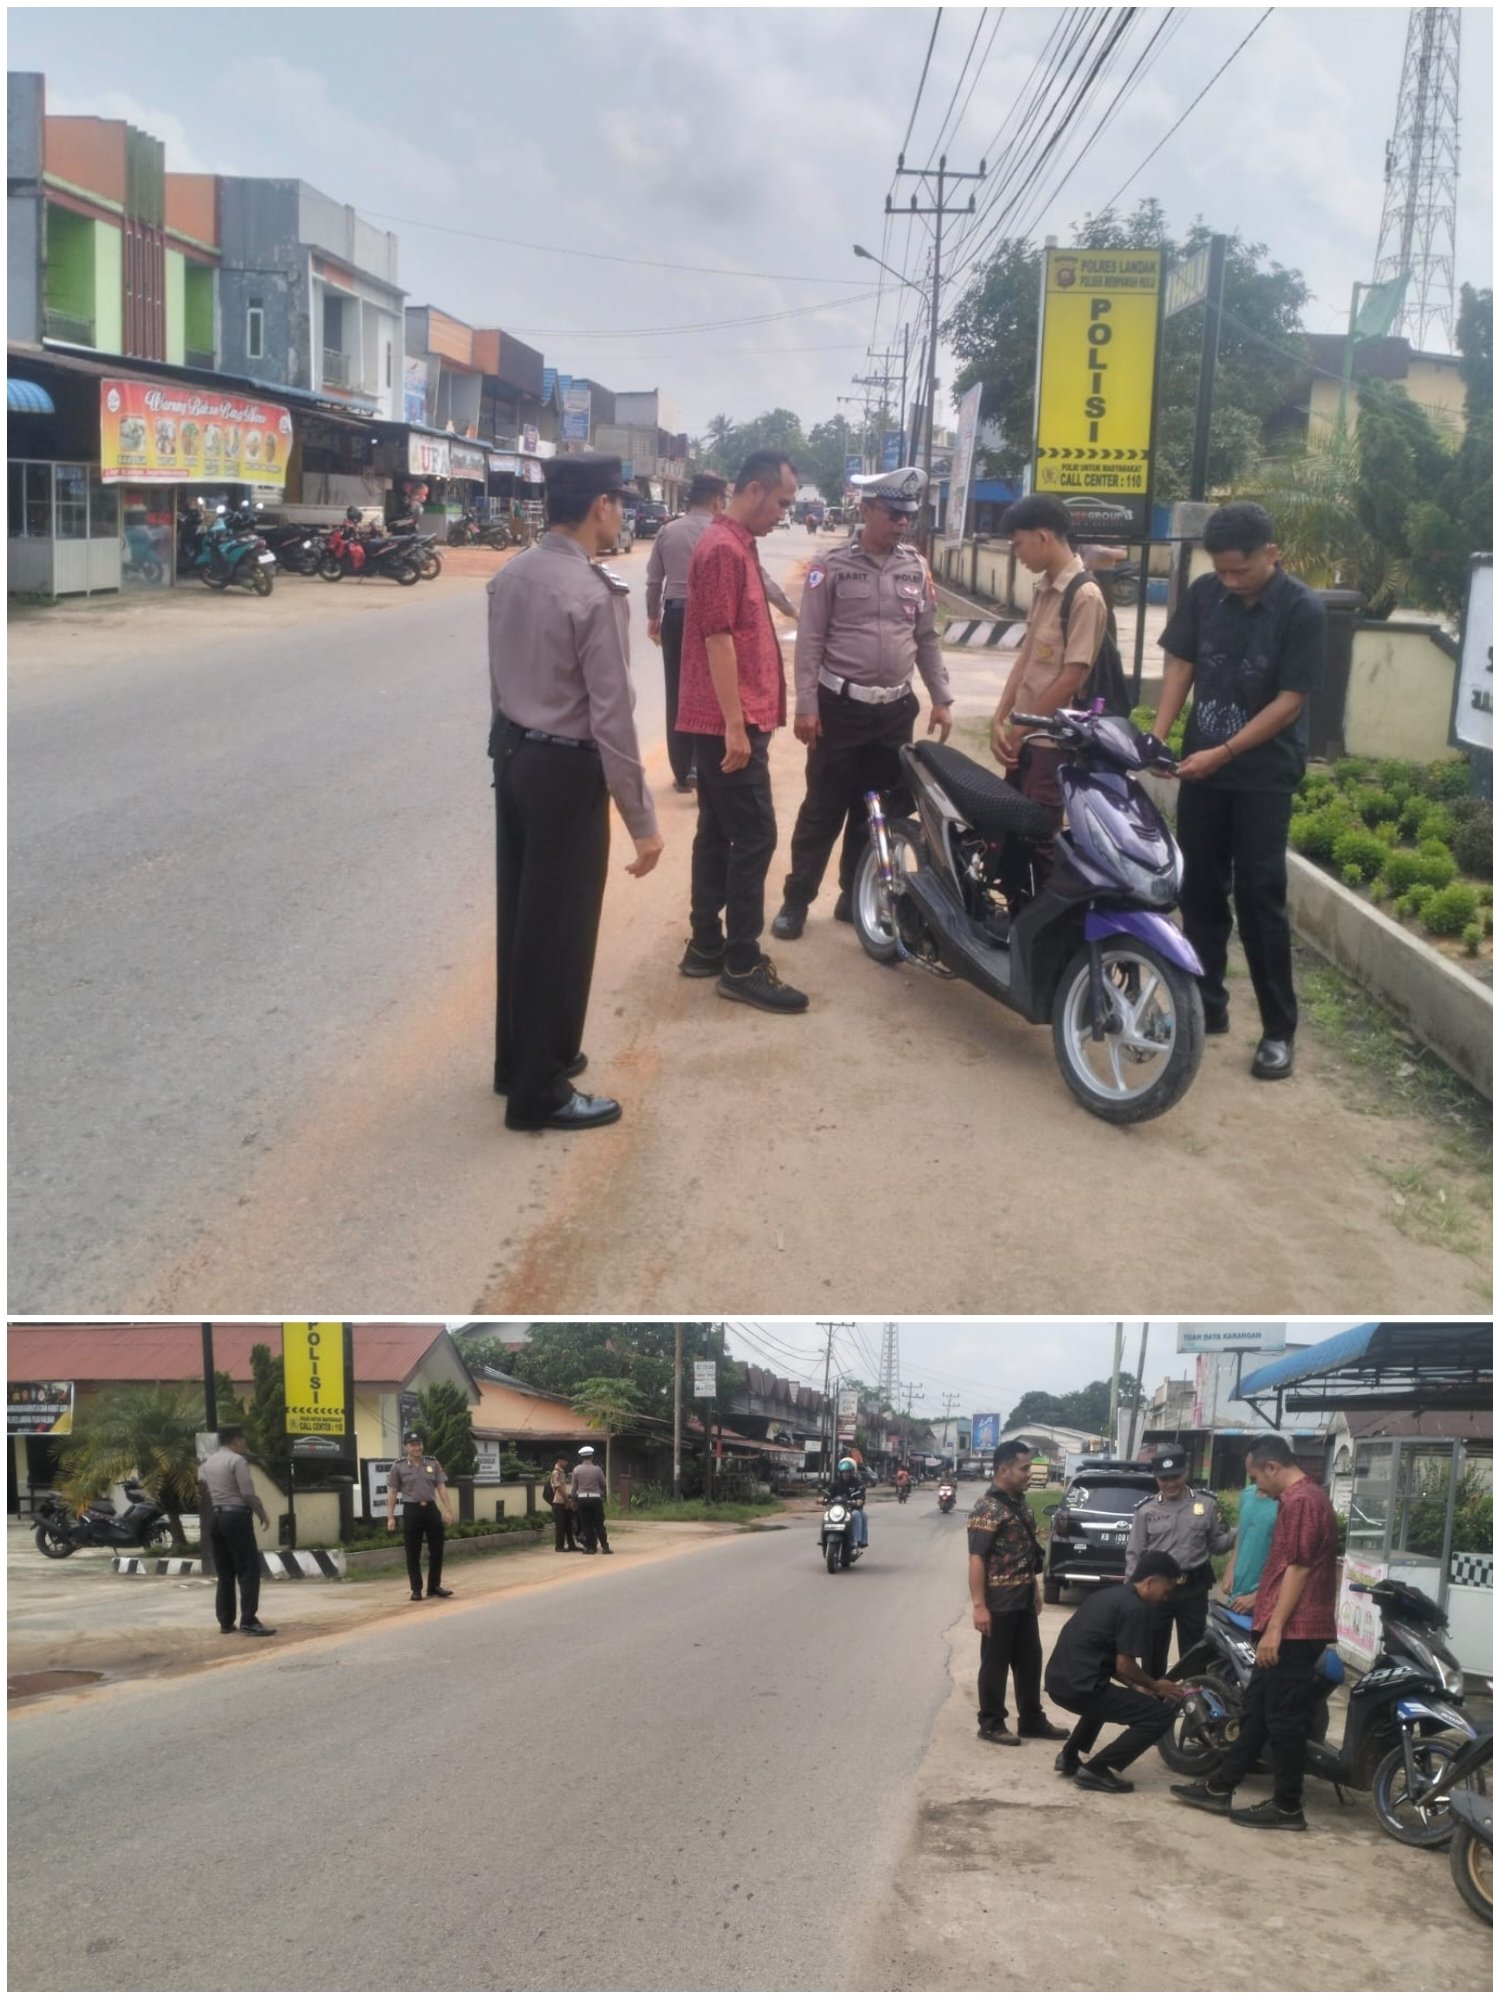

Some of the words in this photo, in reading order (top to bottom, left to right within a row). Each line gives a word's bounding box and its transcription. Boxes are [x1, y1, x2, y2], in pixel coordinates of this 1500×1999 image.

[1081, 260, 1116, 273] POLRES
[1120, 261, 1156, 274] LANDAK
[1085, 298, 1112, 443] POLISI
[1081, 464, 1101, 472] UNTUK
[1102, 465, 1142, 473] MASYARAKAT
[1060, 473, 1082, 487] CALL
[1084, 474, 1119, 488] CENTER
[1126, 475, 1142, 488] 110
[307, 1322, 321, 1404] POLISI
[300, 1421, 312, 1431] CALL
[313, 1422, 331, 1432] CENTER
